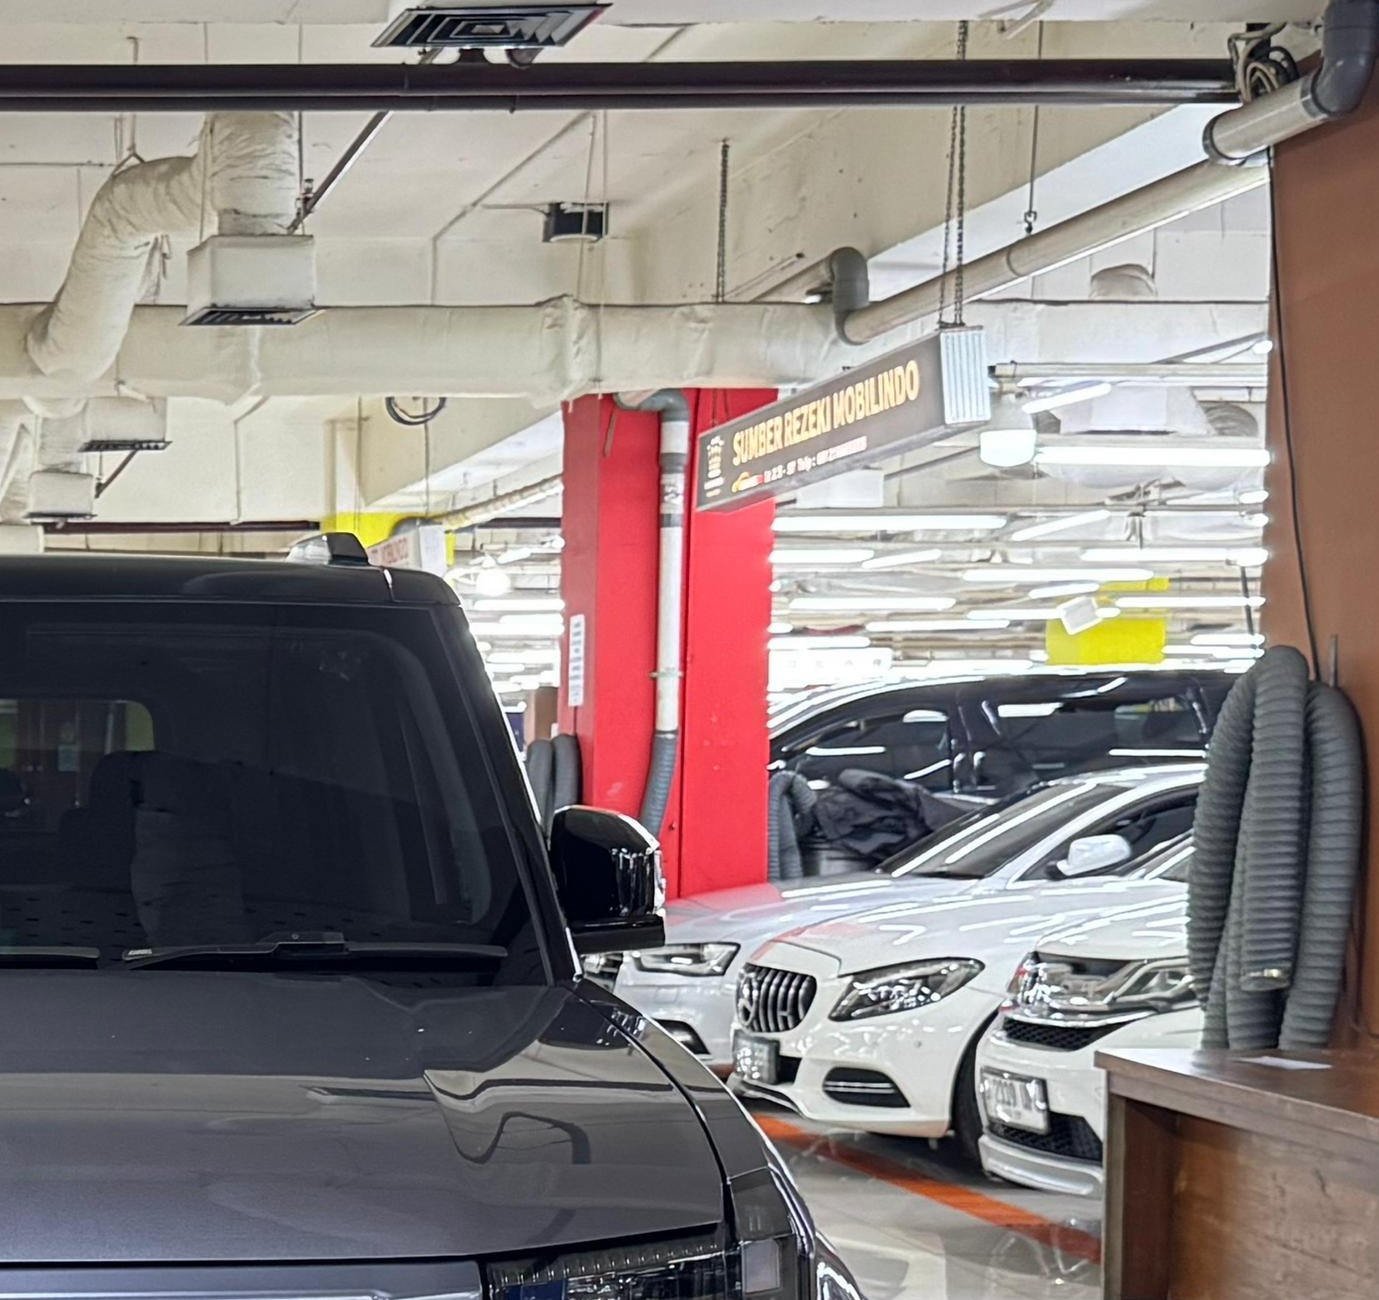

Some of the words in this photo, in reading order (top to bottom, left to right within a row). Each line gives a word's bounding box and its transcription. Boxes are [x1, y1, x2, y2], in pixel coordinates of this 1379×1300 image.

[732, 418, 783, 466] SUMBER
[784, 394, 832, 441] REZEKI
[832, 359, 920, 429] MOBILINDO
